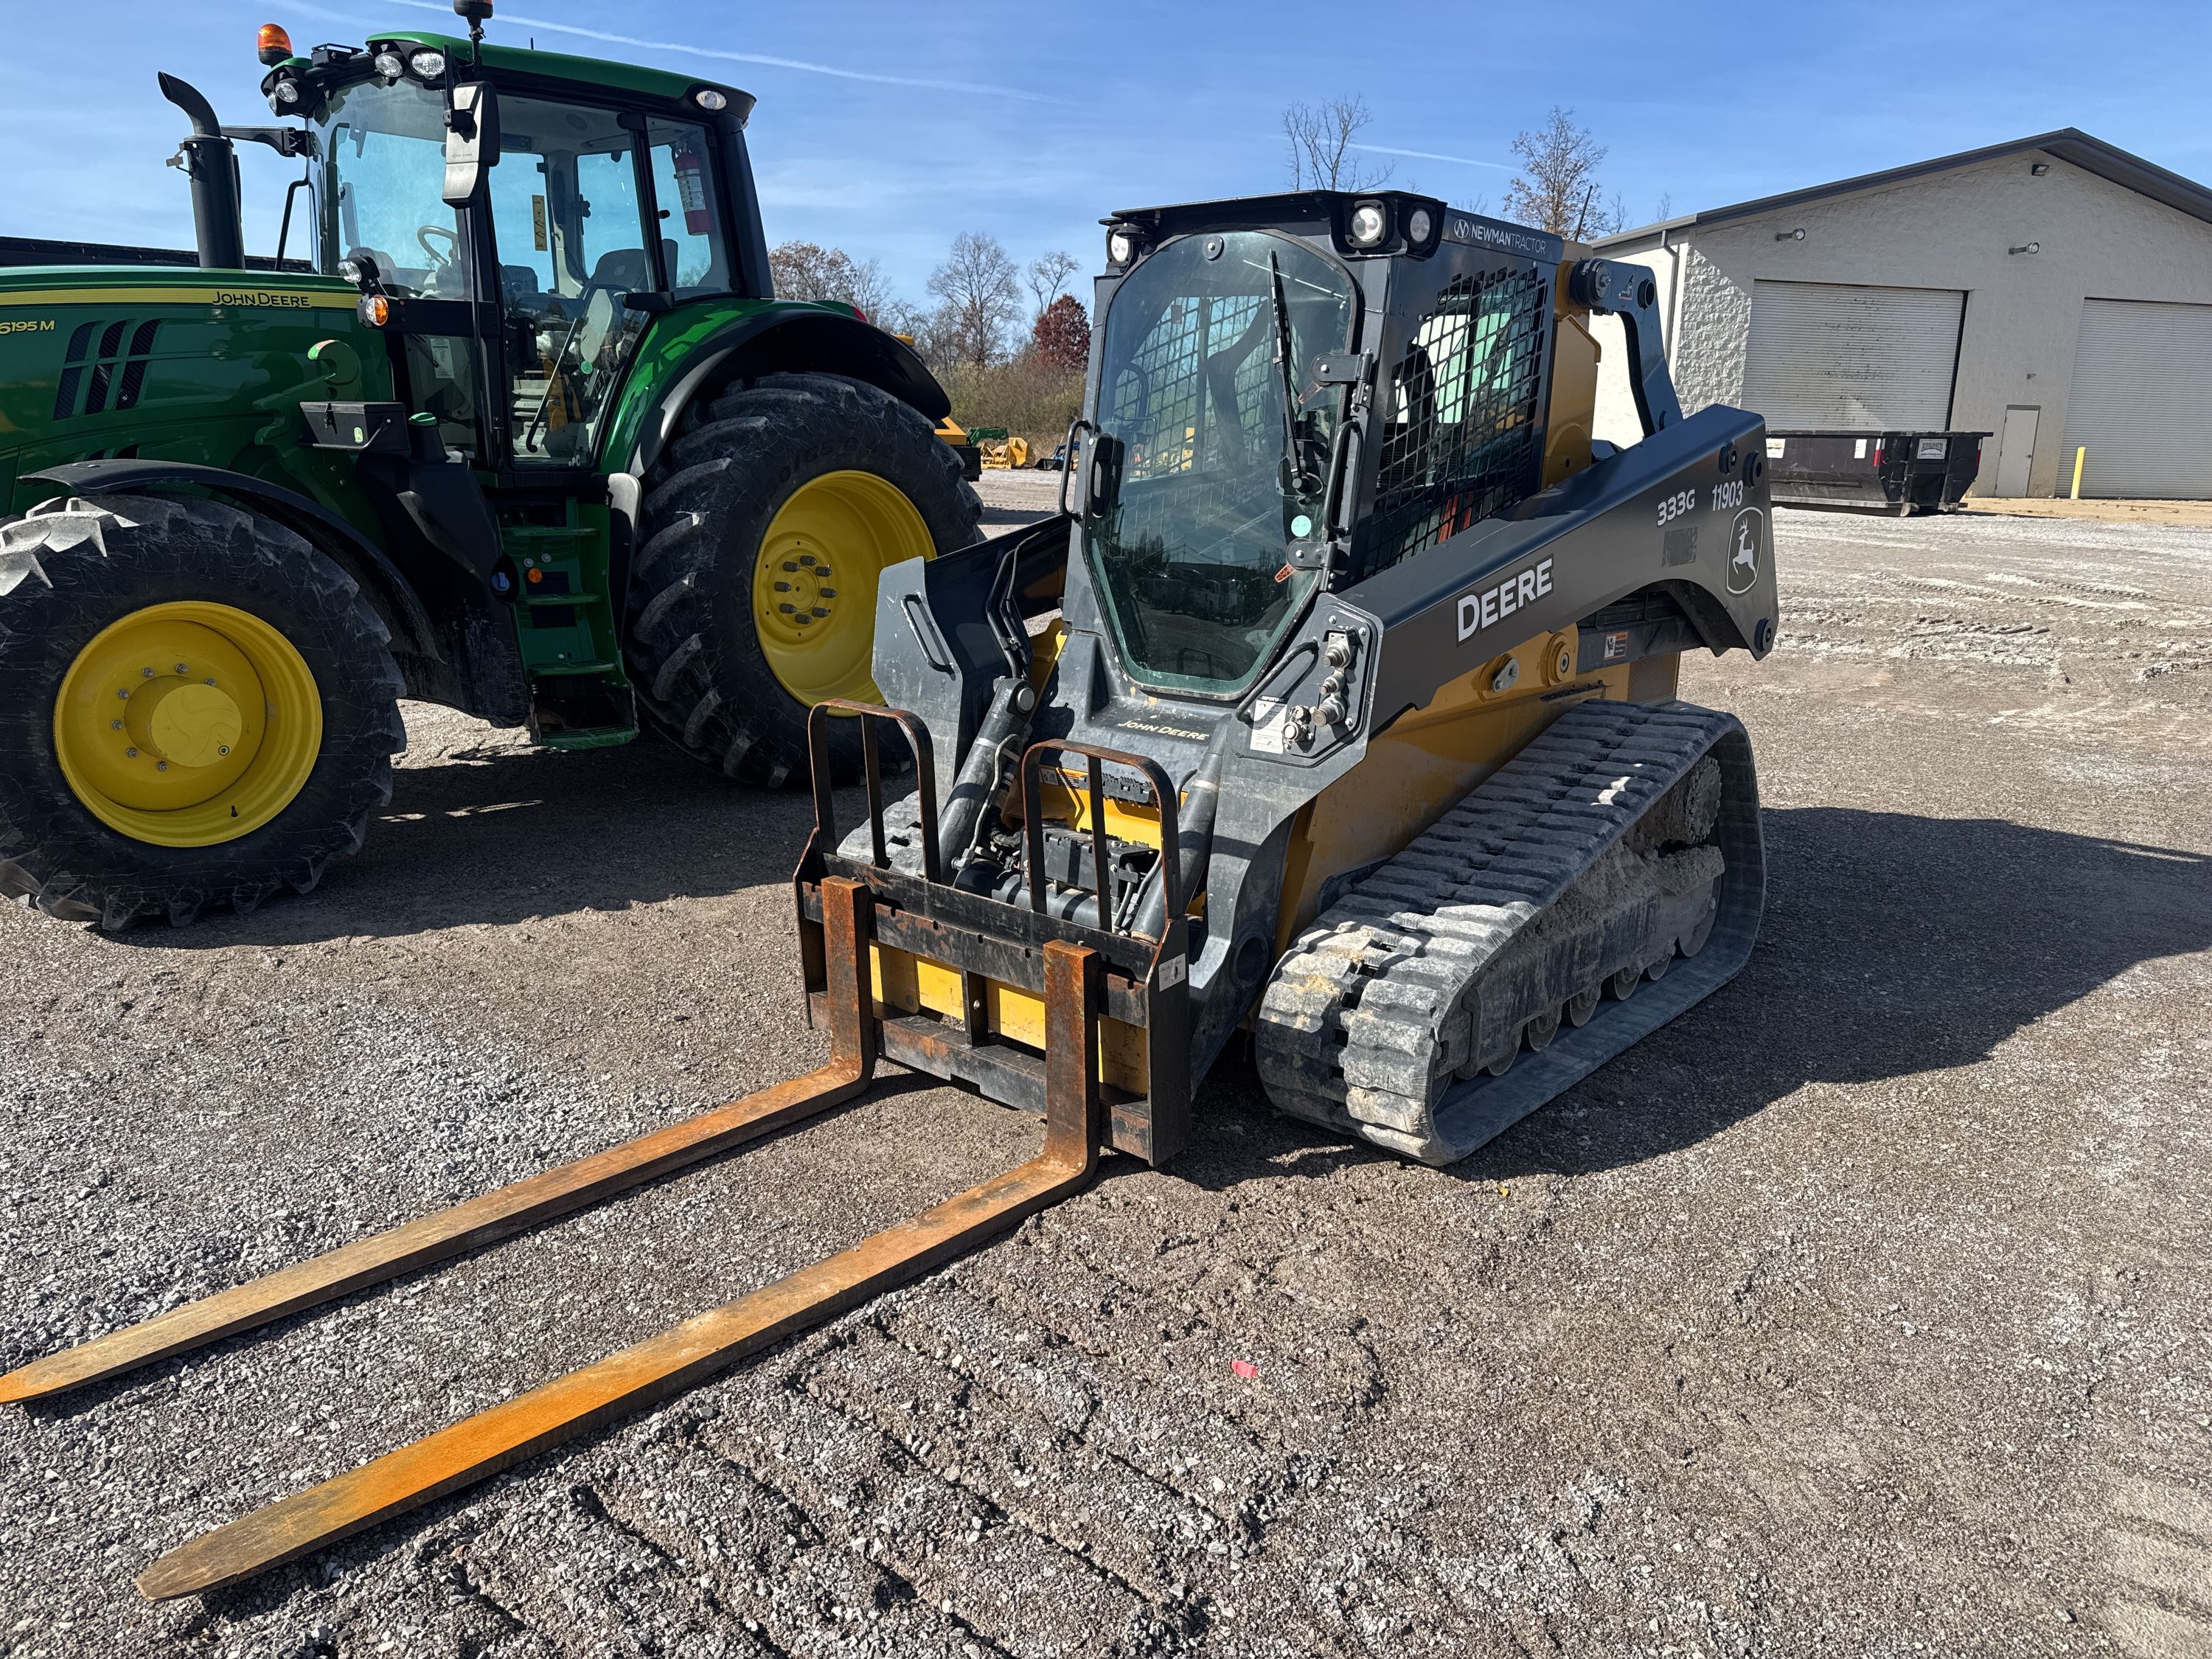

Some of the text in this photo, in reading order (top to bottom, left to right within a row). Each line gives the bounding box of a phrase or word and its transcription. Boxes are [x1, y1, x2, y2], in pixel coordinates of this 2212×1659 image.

[212, 291, 310, 306] JOHN DEERE
[1657, 489, 1695, 526] 333G
[1711, 480, 1744, 511] 11903
[1457, 557, 1553, 642] DEERE
[1117, 720, 1210, 740] JOHN DEERE
